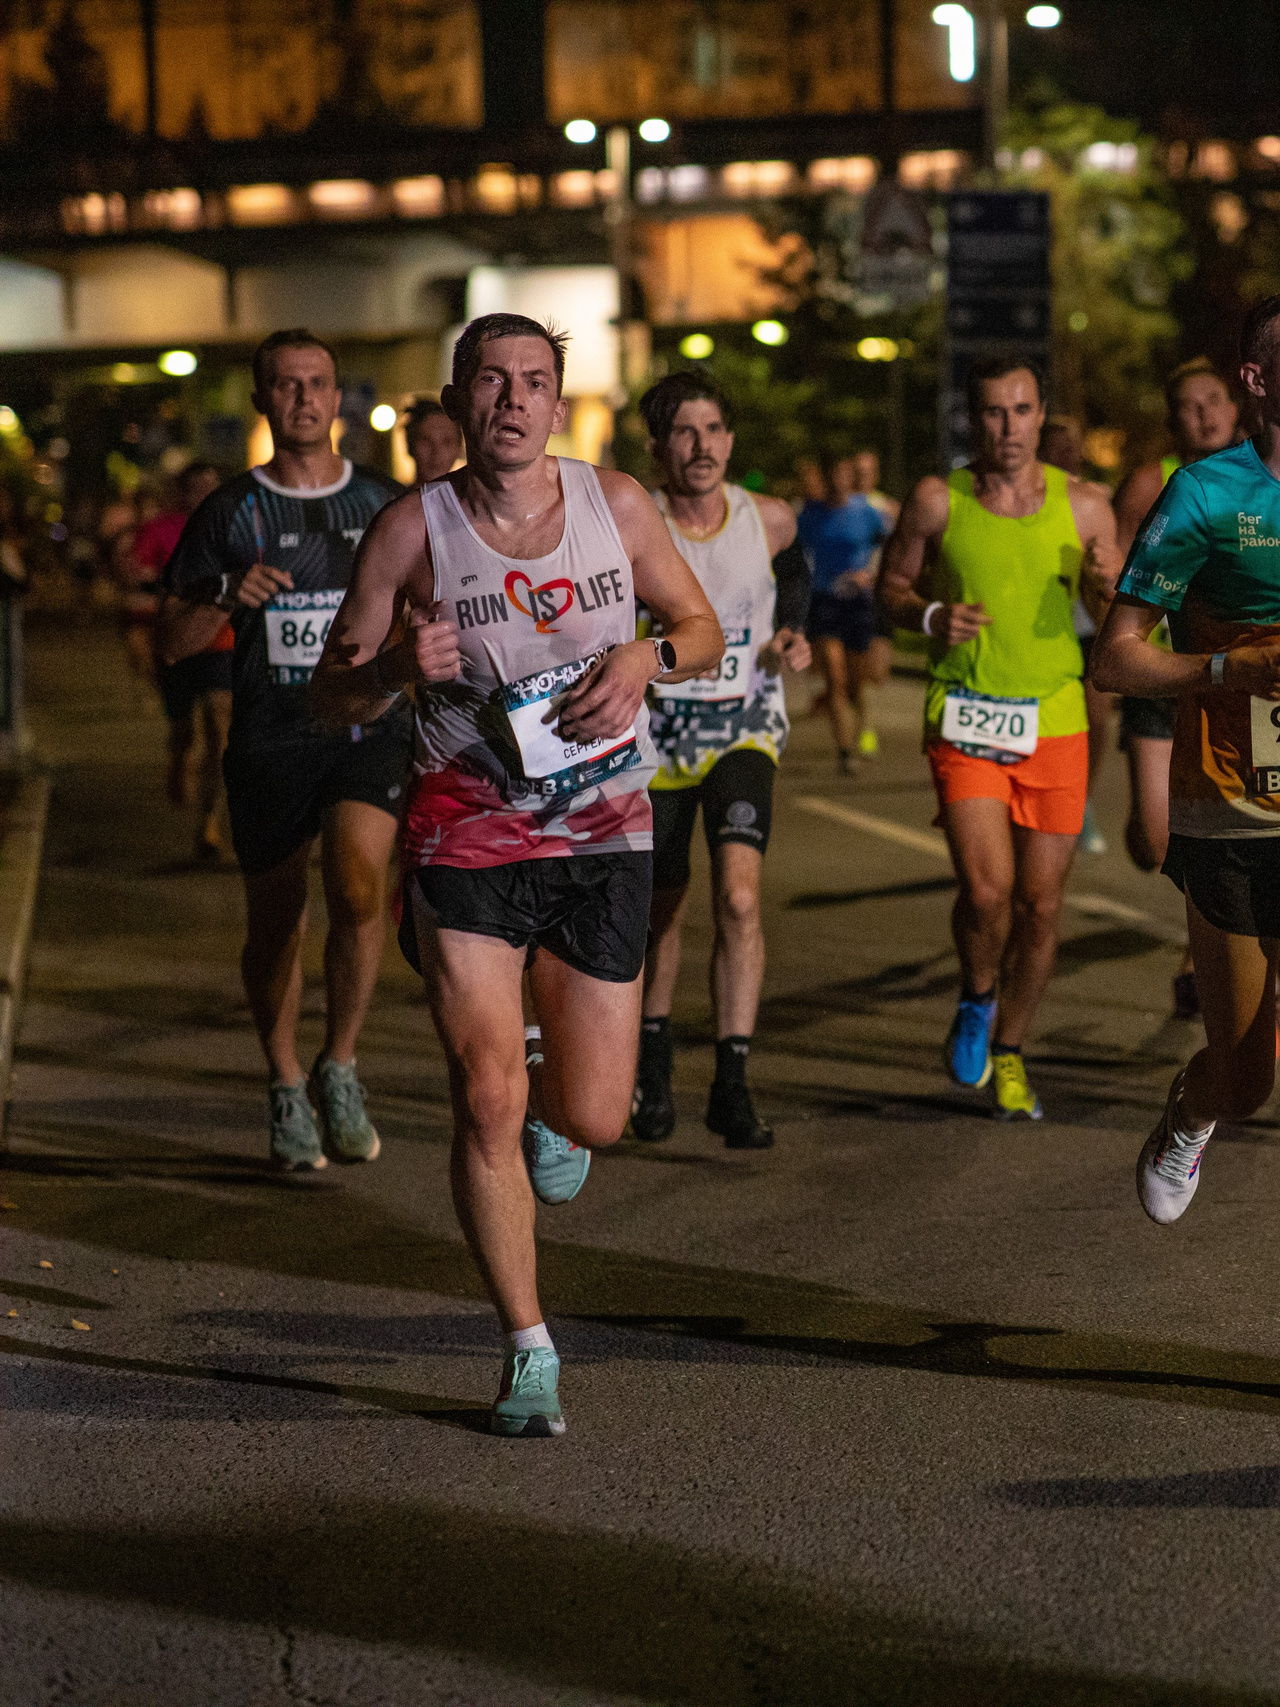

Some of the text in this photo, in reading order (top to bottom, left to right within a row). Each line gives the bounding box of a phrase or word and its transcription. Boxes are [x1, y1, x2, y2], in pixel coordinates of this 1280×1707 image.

[1237, 511, 1262, 525] бег
[1238, 525, 1257, 536] на
[460, 573, 478, 587] gm
[455, 568, 624, 630] RUN IS LIFE
[958, 705, 1025, 738] 5270
